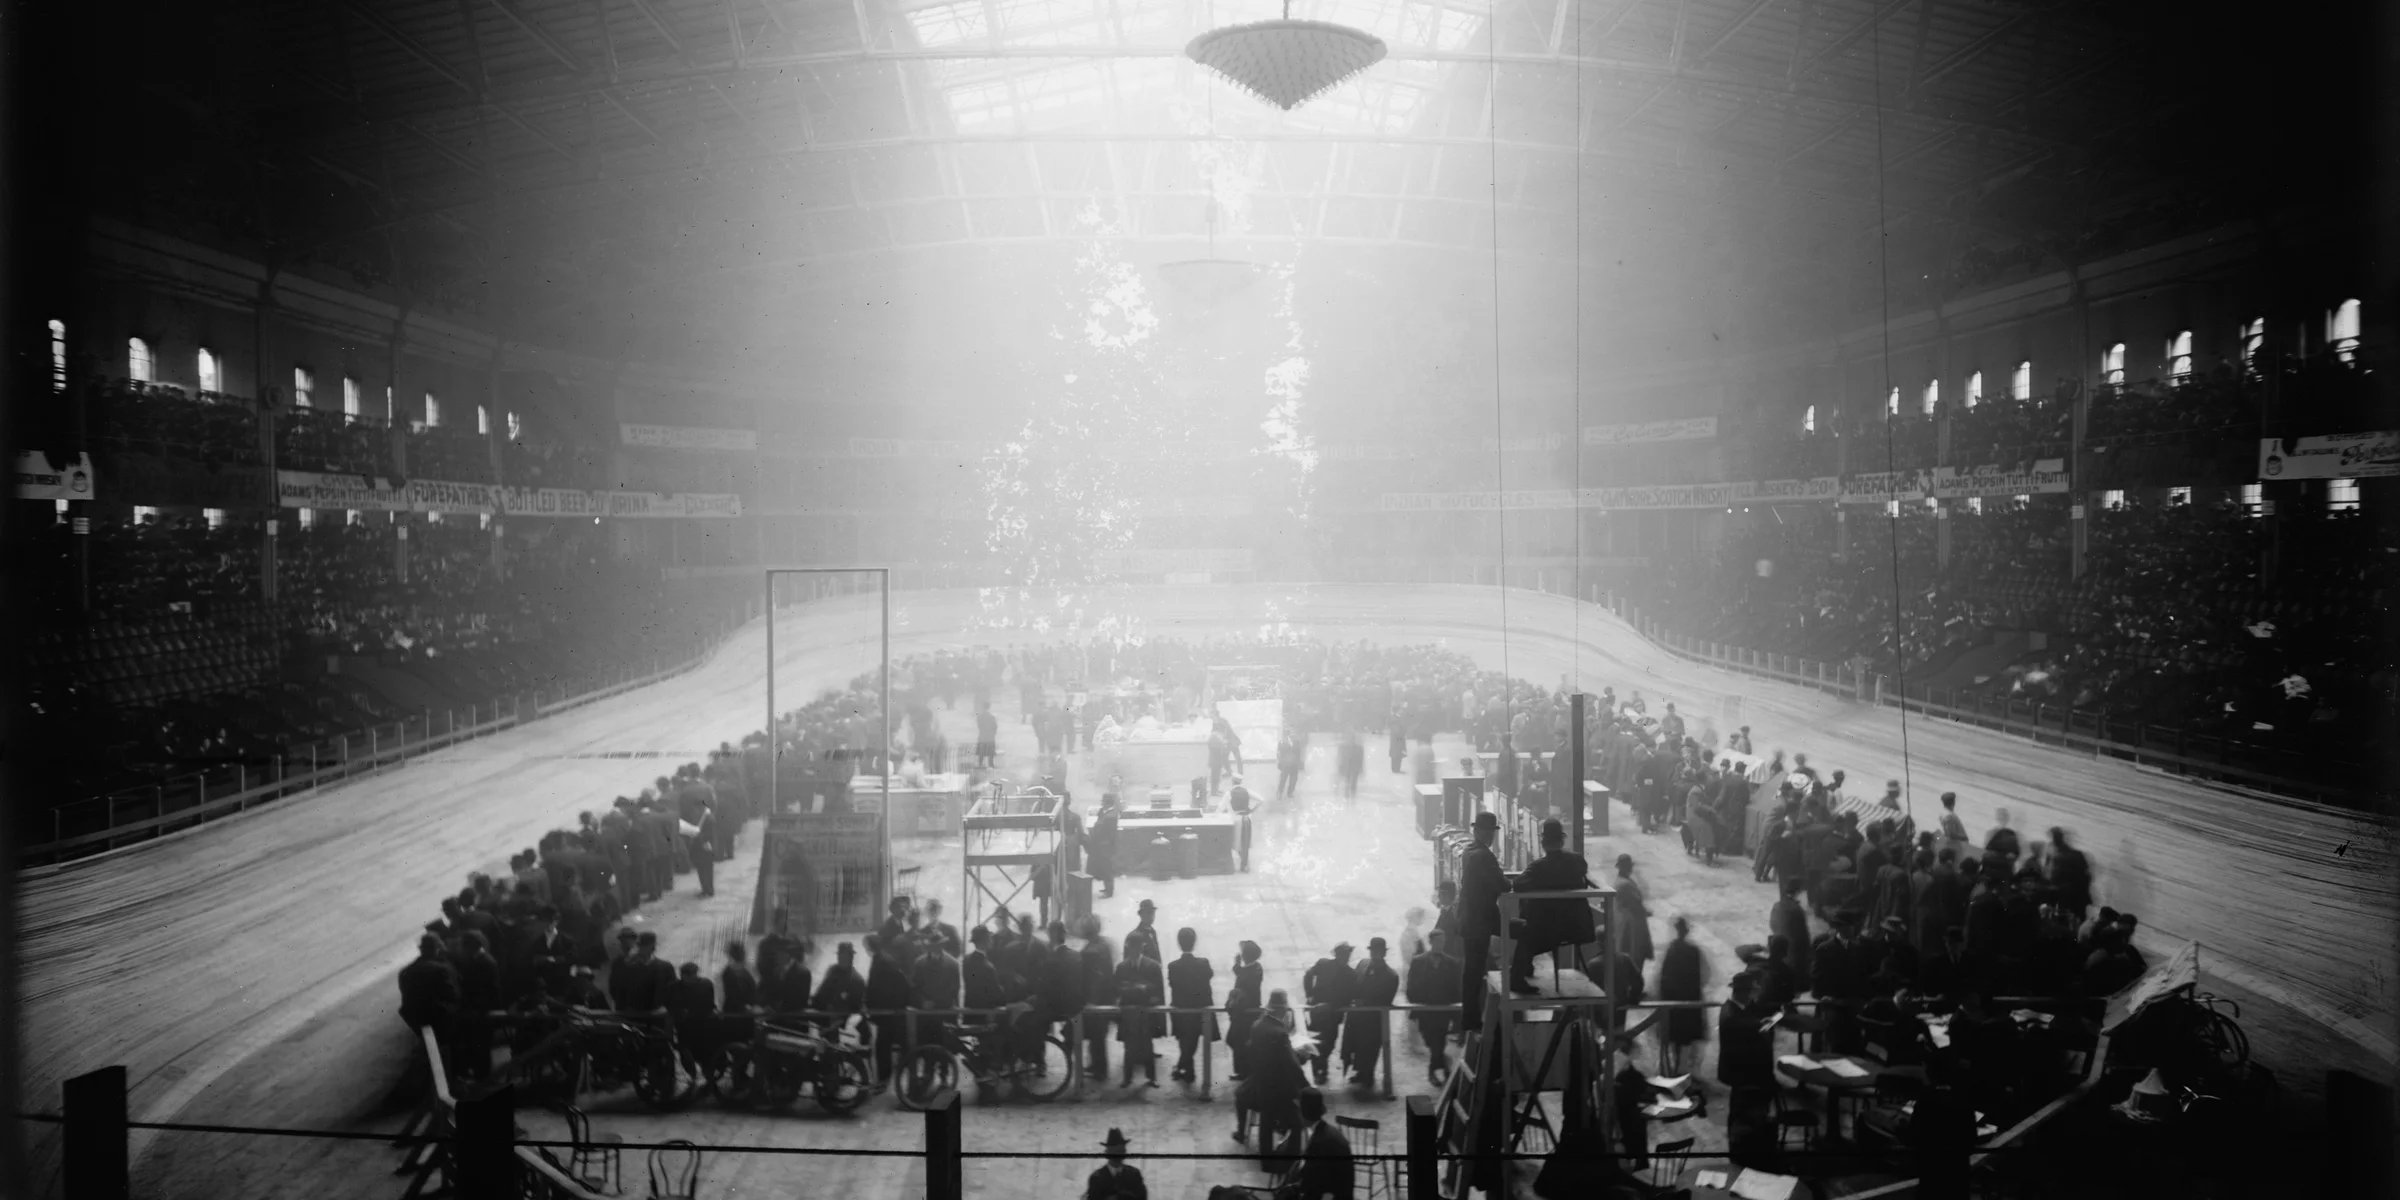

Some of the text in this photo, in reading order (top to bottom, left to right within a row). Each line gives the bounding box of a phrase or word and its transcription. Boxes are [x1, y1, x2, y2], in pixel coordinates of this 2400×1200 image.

[1973, 474, 2004, 488] PEPSIN
[560, 492, 586, 512] BEER
[611, 494, 650, 515] DRINK
[1653, 487, 1692, 506] SCOTCH
